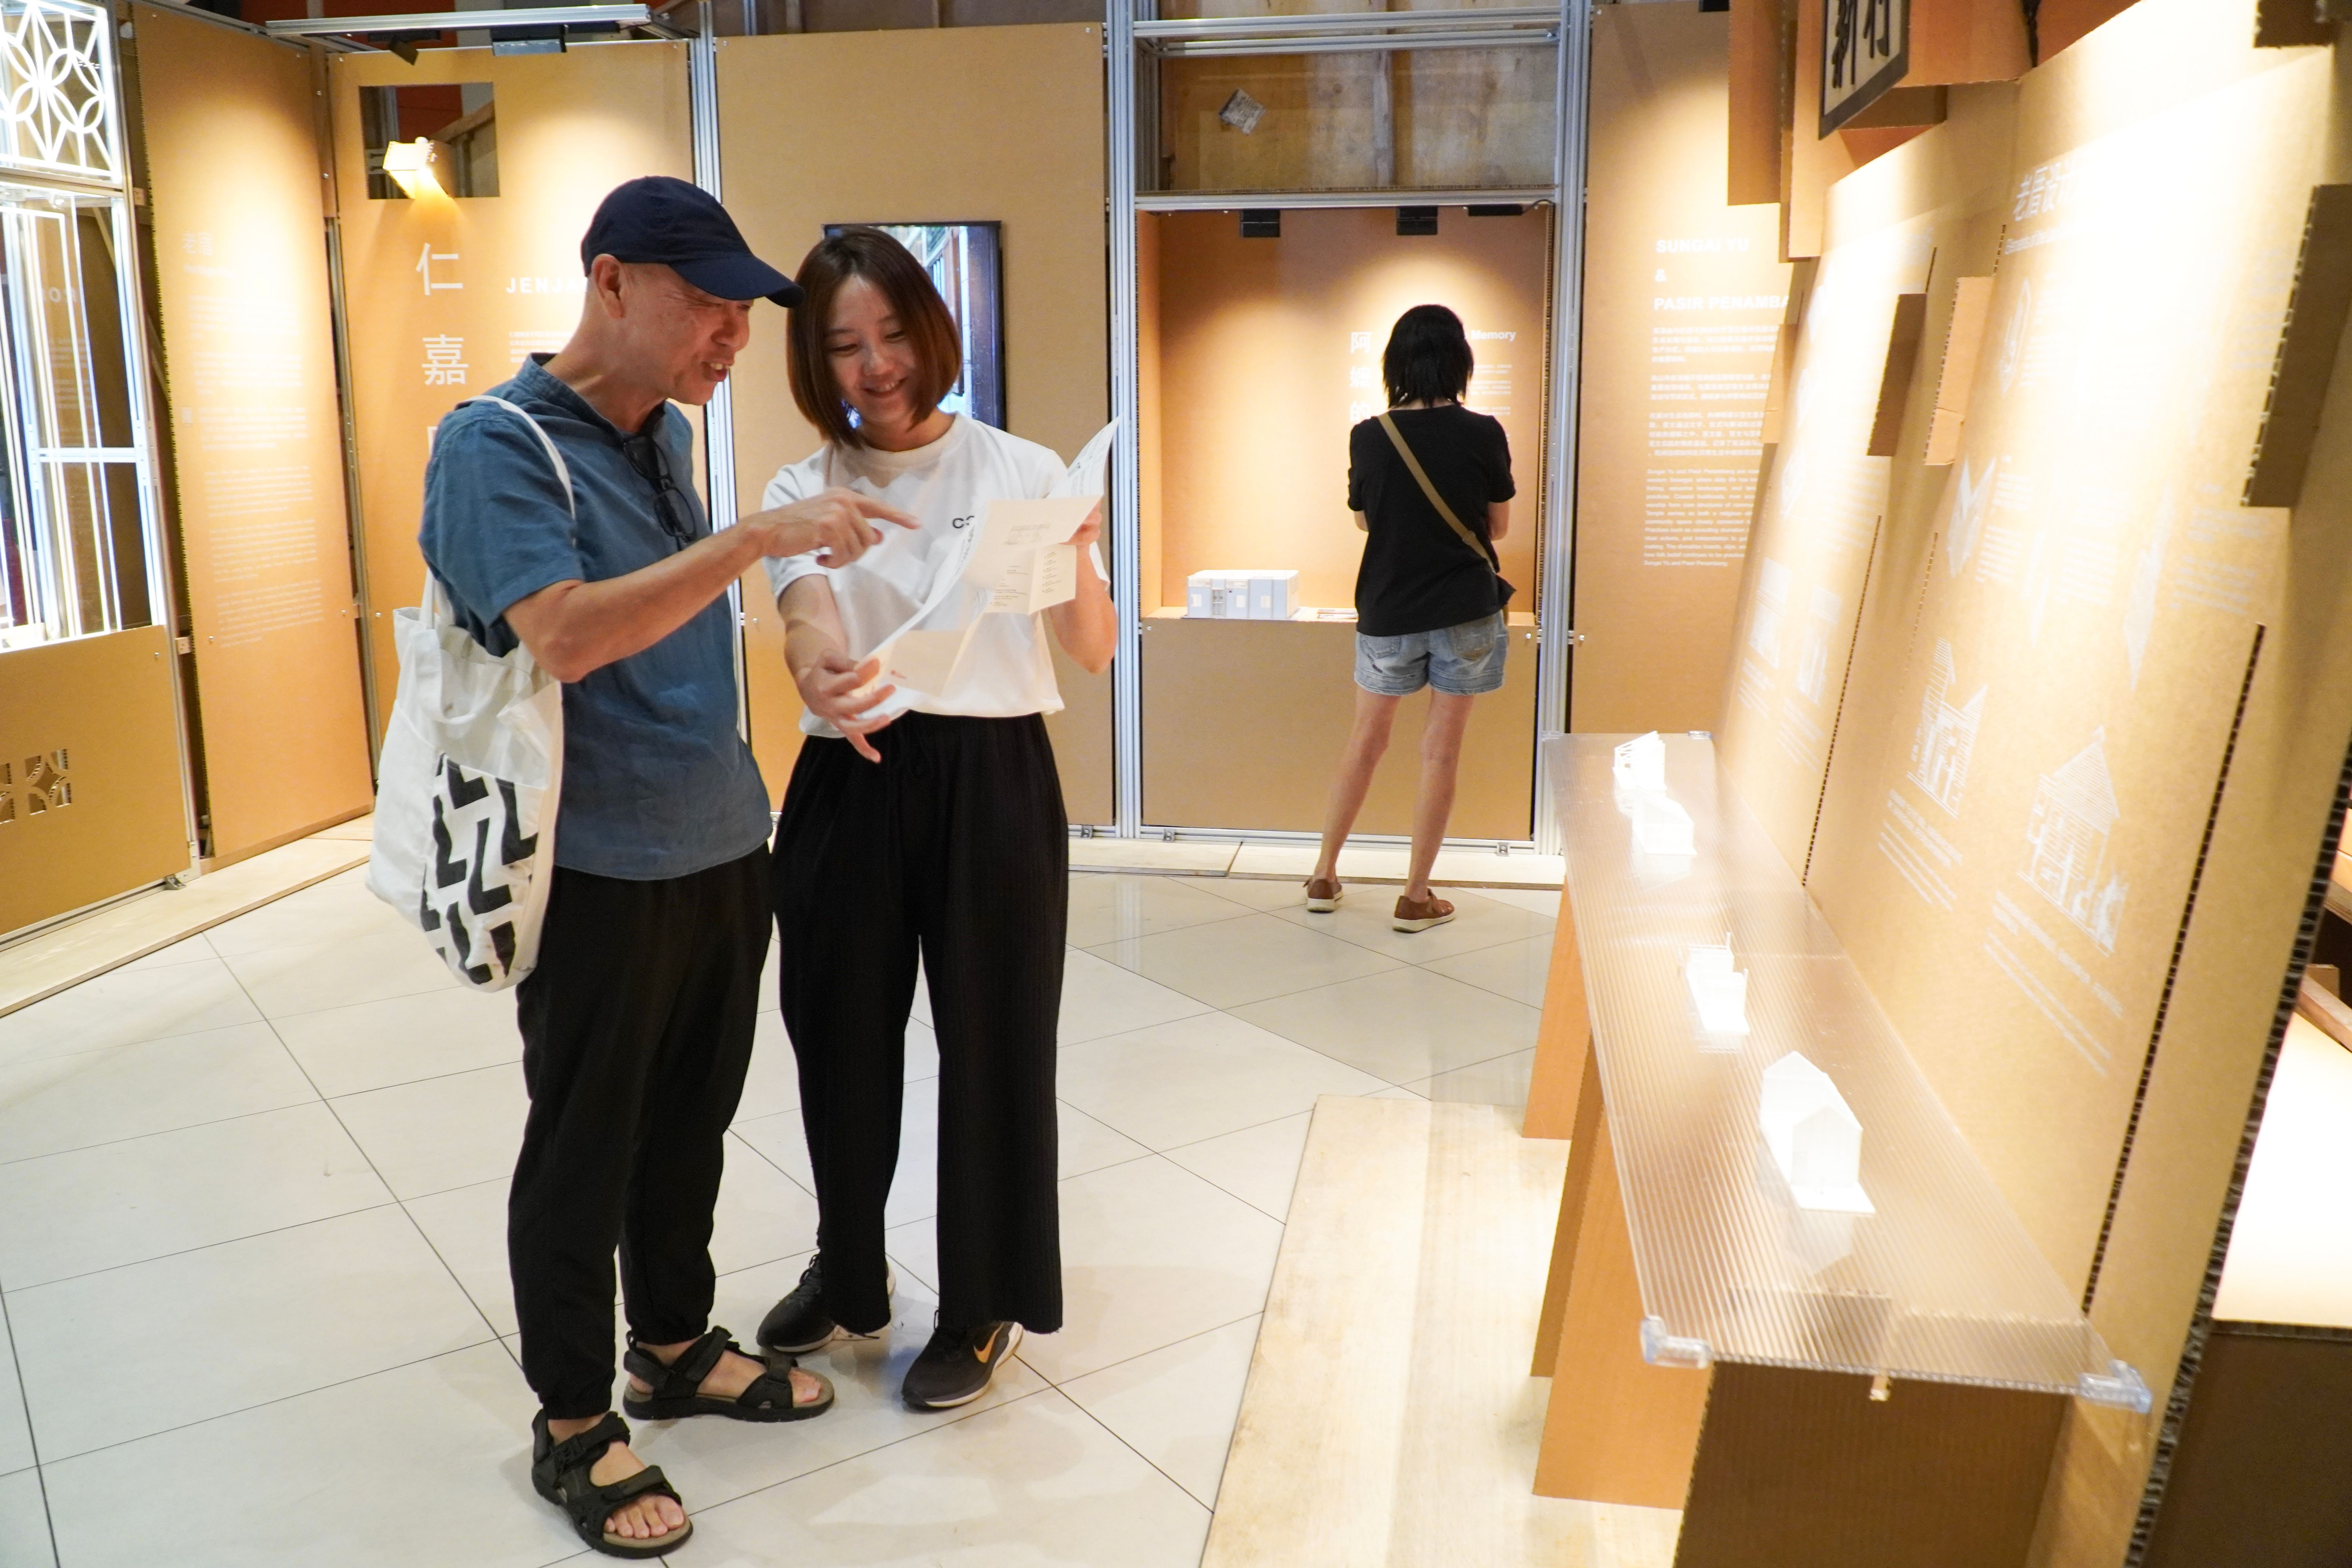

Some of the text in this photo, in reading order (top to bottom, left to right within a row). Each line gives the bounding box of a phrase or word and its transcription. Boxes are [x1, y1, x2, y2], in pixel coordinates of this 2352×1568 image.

[1656, 238, 1749, 254] SUNGAI YU
[1655, 269, 1667, 282] &
[1654, 297, 1704, 311] PASIR
[1471, 330, 1516, 341] Memory
